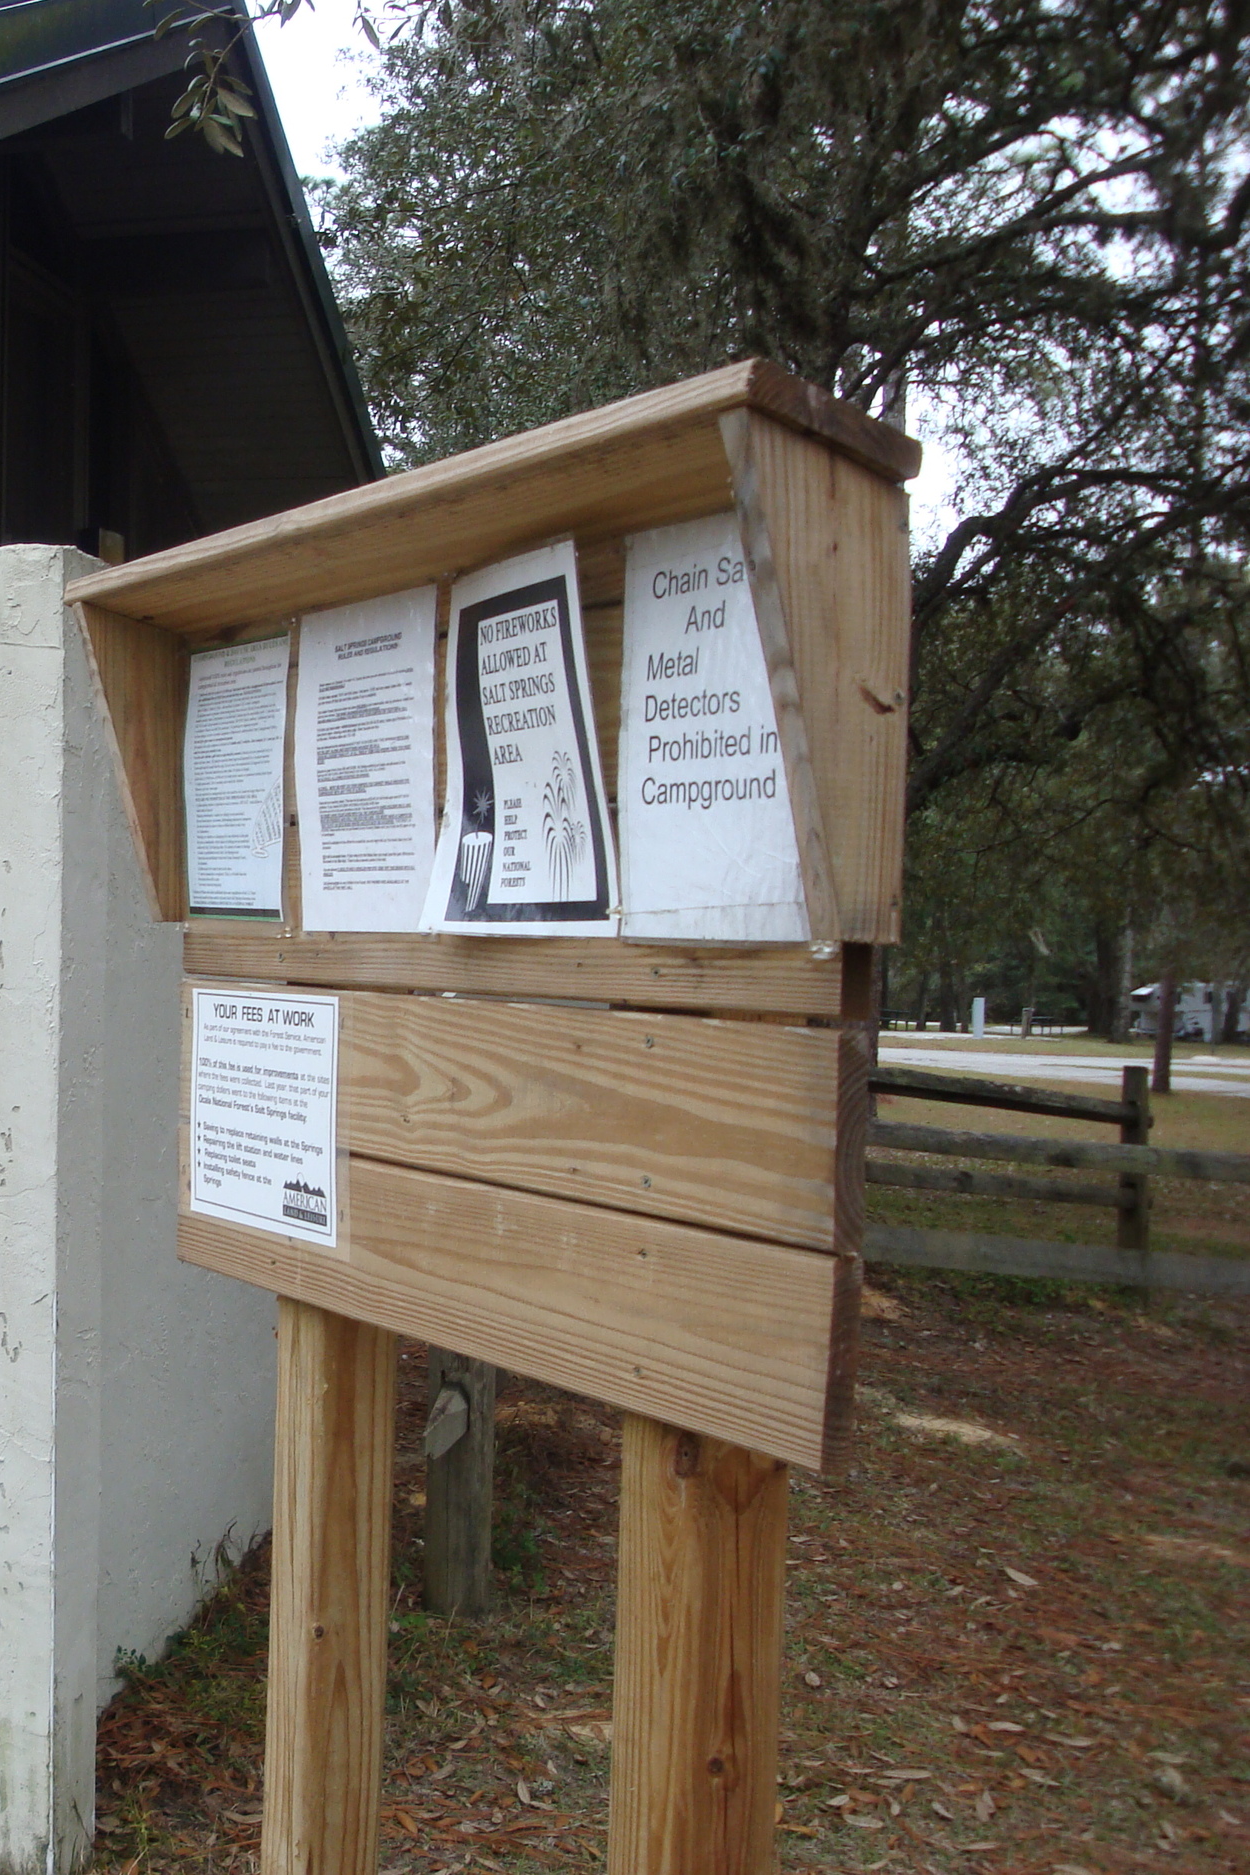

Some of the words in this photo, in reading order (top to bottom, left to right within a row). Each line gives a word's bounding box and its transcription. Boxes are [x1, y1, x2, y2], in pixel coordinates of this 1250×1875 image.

[653, 564, 708, 600] Chain
[716, 557, 744, 586] Sa
[480, 625, 494, 646] NO
[495, 606, 557, 642] FIREWORKS
[685, 600, 726, 634] And
[335, 643, 347, 653] SALT
[348, 640, 367, 650] SPRINGS
[368, 632, 402, 646] CAMPGROUND
[338, 652, 352, 660] RULES
[354, 649, 363, 657] AND
[364, 643, 398, 655] REGULATIONS
[481, 646, 530, 676] ALLOWED
[533, 642, 547, 664] AT
[646, 646, 699, 682] Metal
[482, 683, 506, 706] SALT
[510, 673, 555, 701] SPRINGS
[645, 689, 740, 722] Detectors
[486, 705, 556, 736] RECREATION
[494, 744, 523, 765] AREA
[649, 726, 751, 763] Prohibited
[760, 724, 778, 754] in
[642, 768, 776, 810] Campground
[504, 798, 522, 809] PLEASE
[504, 814, 518, 825] HELP
[504, 829, 527, 841] PROTECT
[503, 846, 515, 856] OUR
[502, 861, 531, 872] NATIONAL
[500, 877, 526, 888] FORESTS
[214, 1003, 237, 1020] YOUR
[242, 1006, 263, 1023] FEES
[268, 1008, 280, 1024] AT
[282, 1010, 315, 1028] WORK
[204, 1034, 214, 1043] Land
[214, 1035, 218, 1043] &
[218, 1036, 232, 1044] Leisure
[237, 1038, 254, 1048] required
[260, 1042, 268, 1051] pay
[293, 1046, 322, 1056] government.
[230, 1027, 252, 1036] agreement
[252, 1028, 261, 1036] with
[270, 1030, 284, 1039] Forest
[303, 1034, 326, 1044] American
[199, 1057, 212, 1068] 100%
[213, 1059, 218, 1068] of
[218, 1060, 227, 1069] this
[228, 1061, 236, 1070] fee
[237, 1062, 241, 1071] is
[242, 1065, 253, 1074] used
[263, 1066, 299, 1080] improvements
[300, 1073, 306, 1081] at
[307, 1074, 316, 1083] the
[317, 1075, 330, 1085] sites
[198, 1070, 211, 1080] where
[220, 1073, 229, 1082] fees
[230, 1076, 241, 1084] were
[241, 1077, 262, 1087] collected.
[264, 1080, 275, 1089] Last
[289, 1084, 299, 1094] that
[300, 1086, 311, 1096] part
[312, 1087, 317, 1097] of
[318, 1090, 329, 1100] your
[198, 1084, 215, 1094] camping
[216, 1085, 230, 1095] dollars
[232, 1089, 242, 1097] went
[258, 1092, 277, 1105] following
[279, 1095, 292, 1106] items
[293, 1098, 299, 1107] at
[300, 1099, 308, 1108] the
[199, 1094, 211, 1104] Ocala
[212, 1097, 232, 1108] National
[234, 1100, 253, 1112] Forest's
[255, 1104, 266, 1114] Salt
[266, 1106, 287, 1121] Springs
[203, 1121, 218, 1135] Saving
[220, 1126, 225, 1134] to
[226, 1127, 244, 1138] replace
[245, 1131, 268, 1146] retaining
[269, 1136, 282, 1146] walls
[284, 1139, 290, 1147] at
[291, 1139, 300, 1150] the
[301, 1141, 323, 1156] Springs
[203, 1135, 225, 1150] Repairing
[227, 1140, 235, 1150] the
[244, 1144, 262, 1155] station
[263, 1148, 272, 1158] and
[273, 1151, 289, 1162] water
[290, 1153, 304, 1165] lines
[204, 1148, 228, 1164] Replacing
[228, 1154, 241, 1165] toilet
[242, 1158, 256, 1168] seats
[204, 1161, 224, 1176] Installing
[226, 1167, 241, 1180] safety
[242, 1170, 255, 1182] fence
[256, 1174, 262, 1183] at
[263, 1176, 272, 1186] the
[204, 1174, 222, 1188] Springs
[283, 1191, 327, 1214] AMERICAN
[284, 1205, 298, 1218] LAND
[305, 1210, 326, 1225] LEISURE
